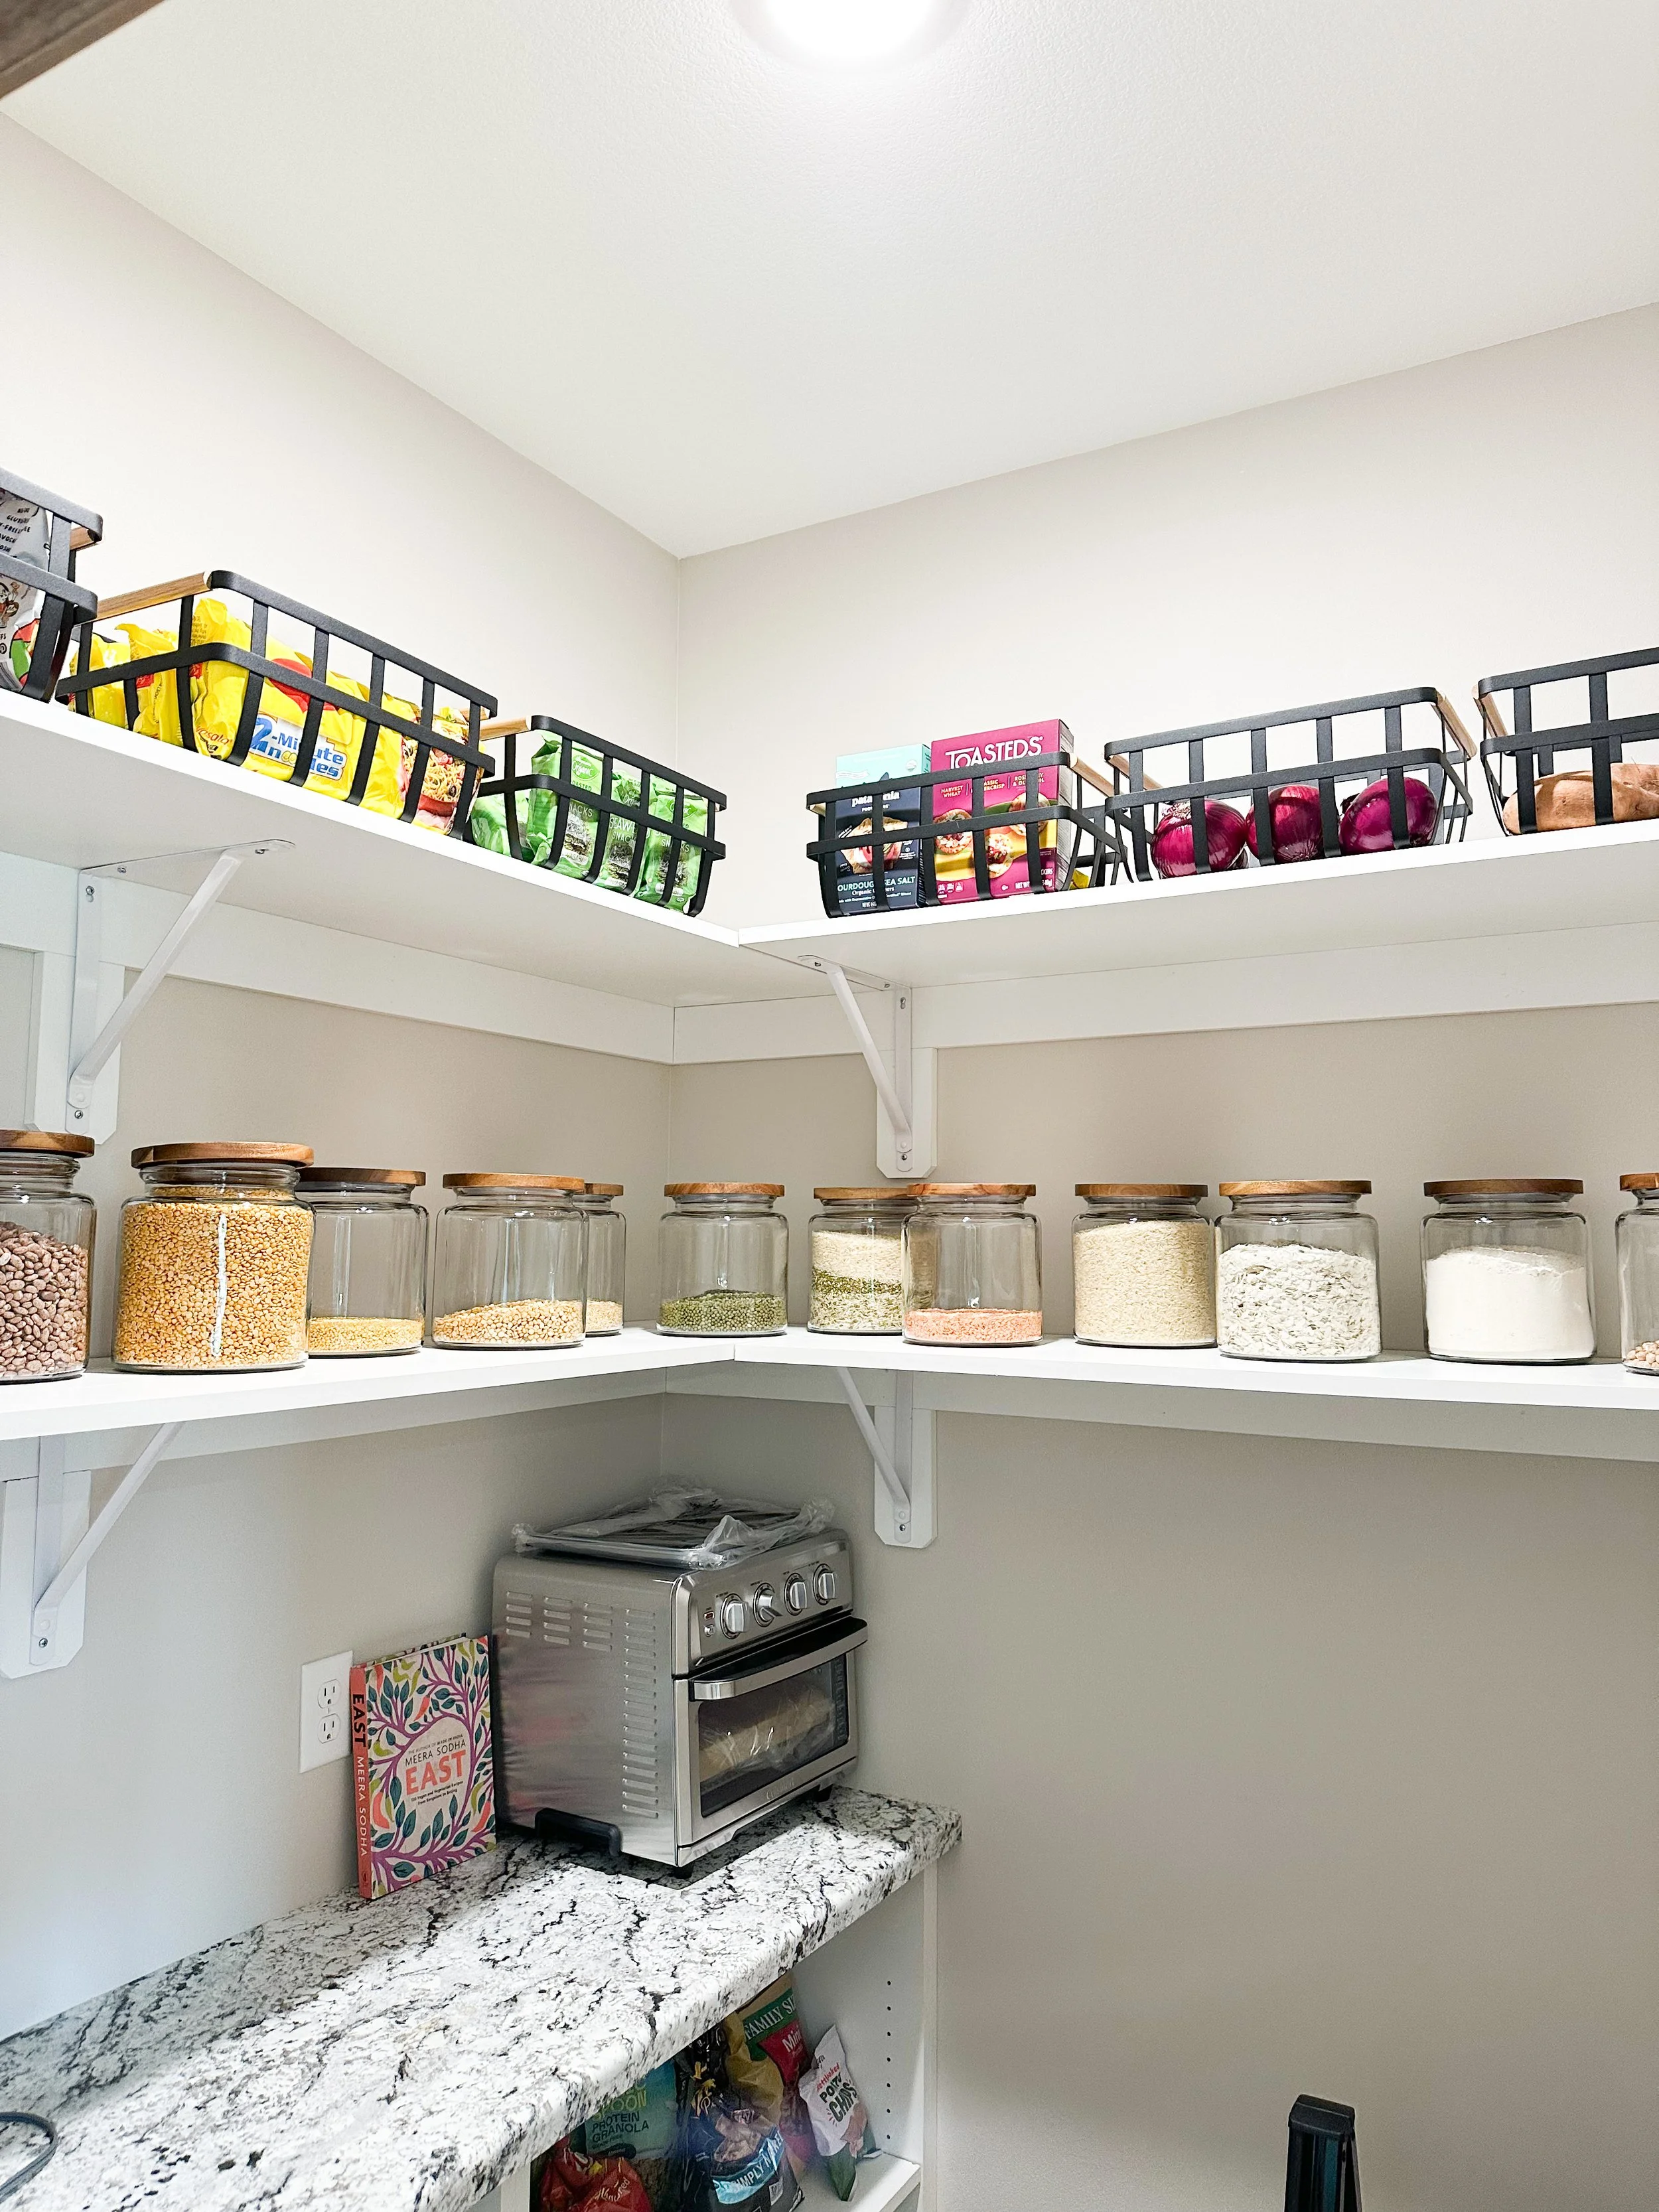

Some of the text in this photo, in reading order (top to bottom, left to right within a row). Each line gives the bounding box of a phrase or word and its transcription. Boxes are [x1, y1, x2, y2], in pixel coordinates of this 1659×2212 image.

[251, 717, 343, 765] 2-Miute
[945, 735, 1042, 769] TOASTEDS
[571, 780, 592, 791] OASTED
[941, 785, 964, 794] HARVEST
[569, 802, 593, 817] NACKS
[851, 791, 900, 807] patania
[613, 831, 636, 843] SNAC
[661, 838, 690, 852] SNKS
[837, 881, 875, 892] OURDOUG
[897, 876, 916, 885] SALT
[353, 1694, 366, 1747] EAST
[405, 1739, 466, 1767] MEERA SODHA
[405, 1749, 467, 1796] EAST
[357, 1756, 368, 1856] MEERA SODHA
[744, 2006, 785, 2041] FAMILY
[592, 2110, 640, 2134] PROTEIN
[592, 2120, 649, 2143] GRANOLA
